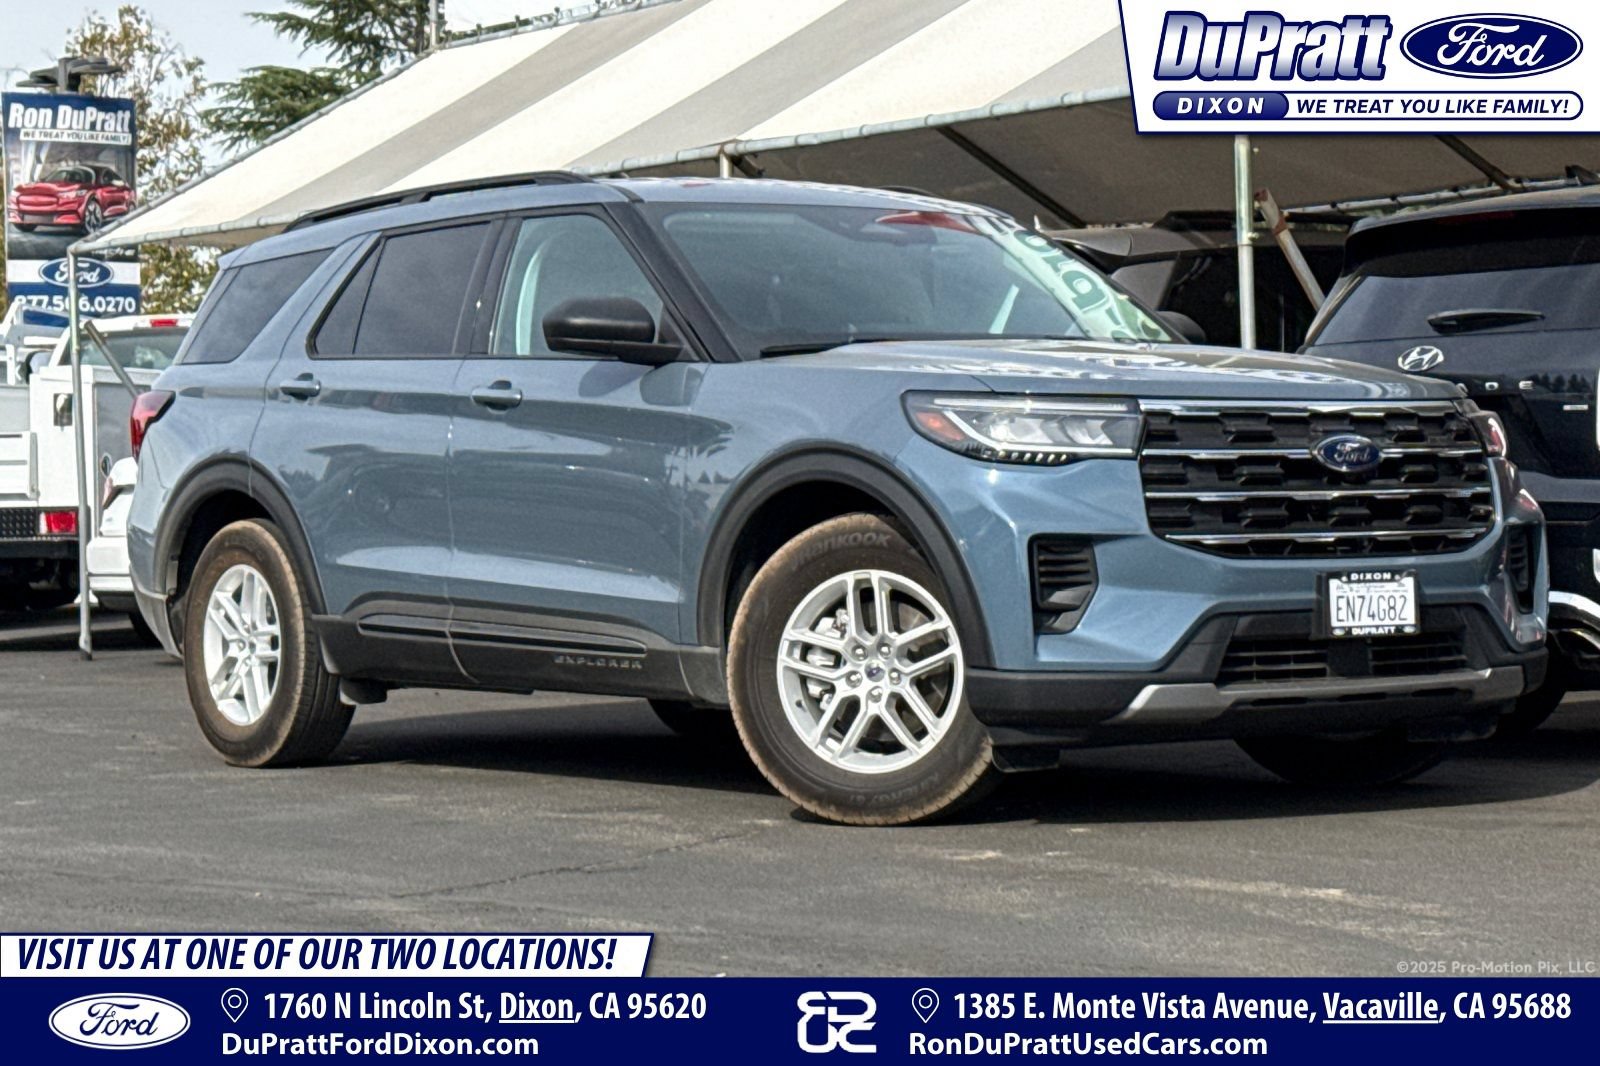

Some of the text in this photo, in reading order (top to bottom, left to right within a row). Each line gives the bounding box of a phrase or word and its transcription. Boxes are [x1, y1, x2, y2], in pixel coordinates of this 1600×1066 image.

[8, 102, 131, 133] Ron DuPratt
[23, 130, 36, 138] WE
[39, 131, 65, 139] TREAT
[67, 132, 84, 140] YOU
[84, 133, 100, 141] LIKE
[54, 261, 100, 283] Frd
[1334, 442, 1372, 462] Ford
[1350, 572, 1392, 581] DIXON
[1336, 595, 1408, 623] EN74G82
[1351, 626, 1397, 636] DUPRATT
